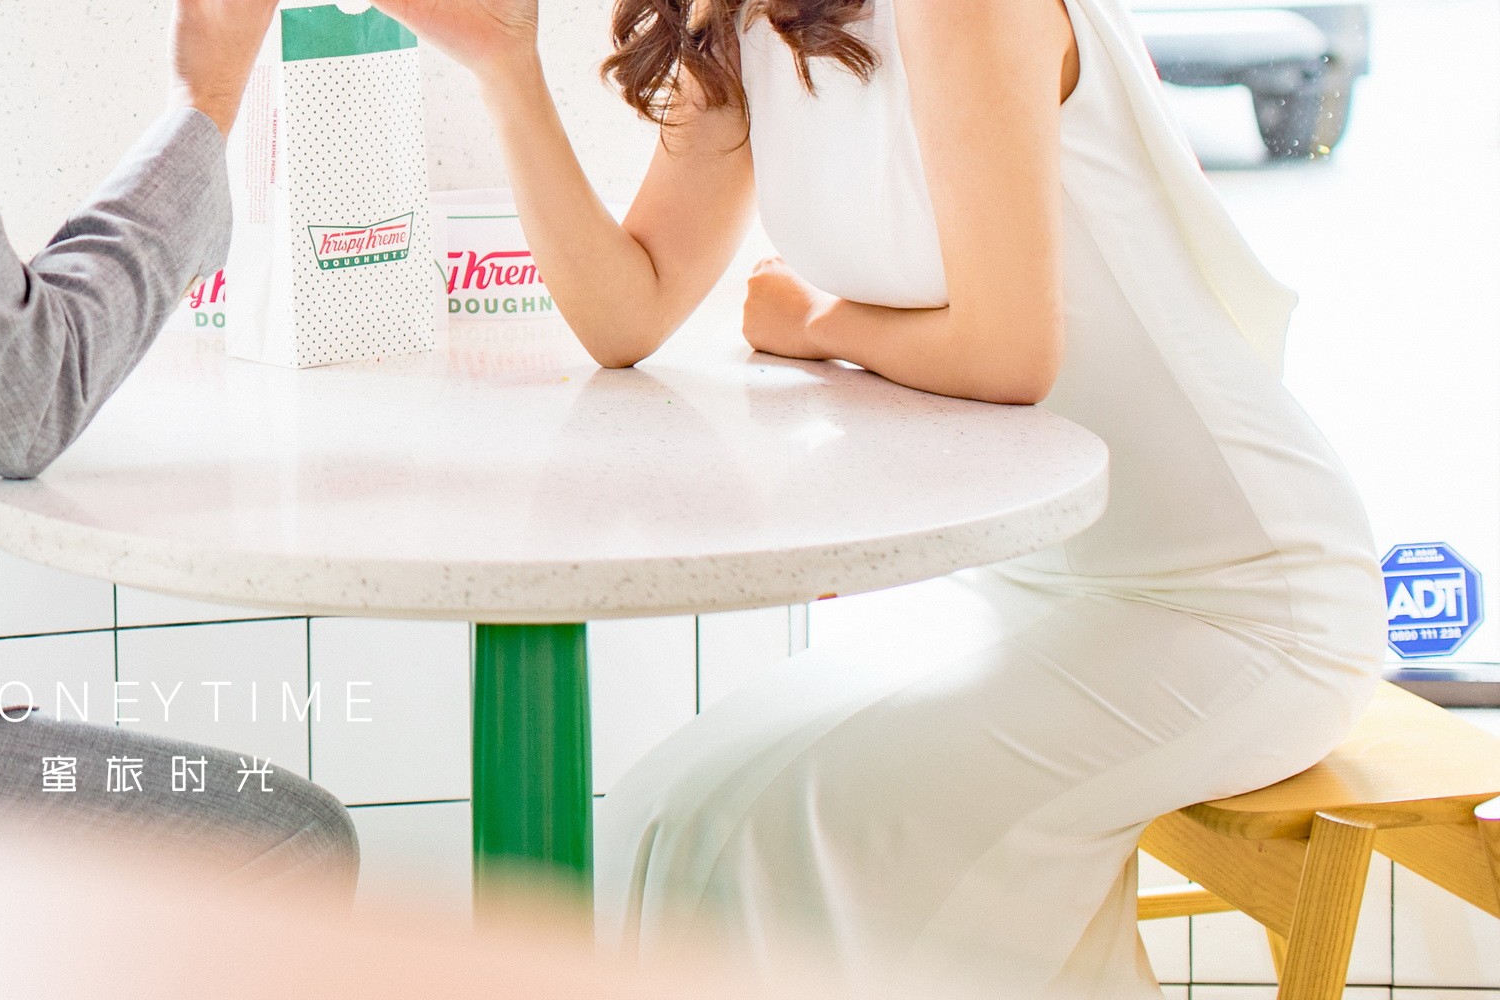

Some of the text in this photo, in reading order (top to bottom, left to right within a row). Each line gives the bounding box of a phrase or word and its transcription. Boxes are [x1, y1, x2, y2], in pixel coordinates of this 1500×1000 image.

[319, 223, 407, 255] Krispy Kreme
[323, 251, 406, 268] DOUGHNUTS
[1387, 579, 1463, 620] ADT
